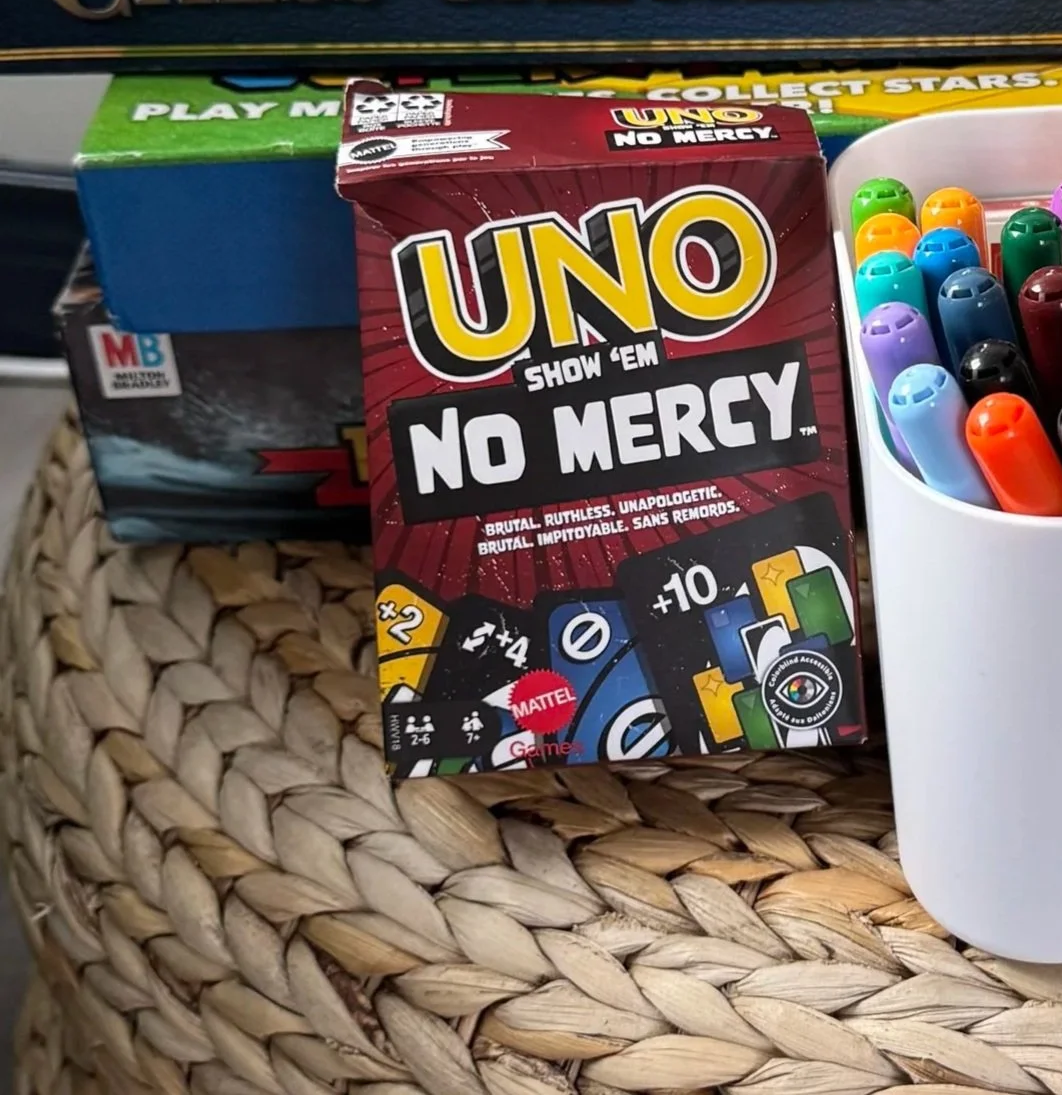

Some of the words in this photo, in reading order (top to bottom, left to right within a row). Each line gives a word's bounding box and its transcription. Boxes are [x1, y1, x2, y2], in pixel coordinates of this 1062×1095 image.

[131, 101, 279, 121] PLAY
[646, 80, 870, 102] COLLECT
[884, 71, 1059, 94] STARS.
[610, 106, 764, 128] UNO
[350, 143, 397, 160] MATTEL
[614, 130, 662, 147] NO
[395, 187, 776, 378] UNO
[101, 334, 165, 368] MB
[111, 378, 171, 390] BRADLEY
[114, 371, 166, 381] MILTON
[524, 351, 601, 392] SHOW
[409, 407, 526, 495] NO
[484, 517, 541, 536] BRUTAL.
[544, 505, 616, 526] RUTHLESS.
[618, 486, 722, 513] UNAPOLOGETIC.
[477, 536, 534, 555] BRUTAL.
[537, 523, 629, 546] IMPITOYABLE.
[632, 512, 669, 530] SANS
[672, 501, 740, 524] REMORDS.
[653, 564, 718, 615] +10
[496, 629, 530, 669] +4
[768, 656, 799, 687] Colorblind
[800, 656, 834, 681] Accessible
[512, 687, 577, 720] MATTEL
[806, 691, 837, 724] Daltoniens
[411, 734, 431, 746] 2-6
[466, 733, 481, 744] 7+
[510, 740, 584, 758] Games
